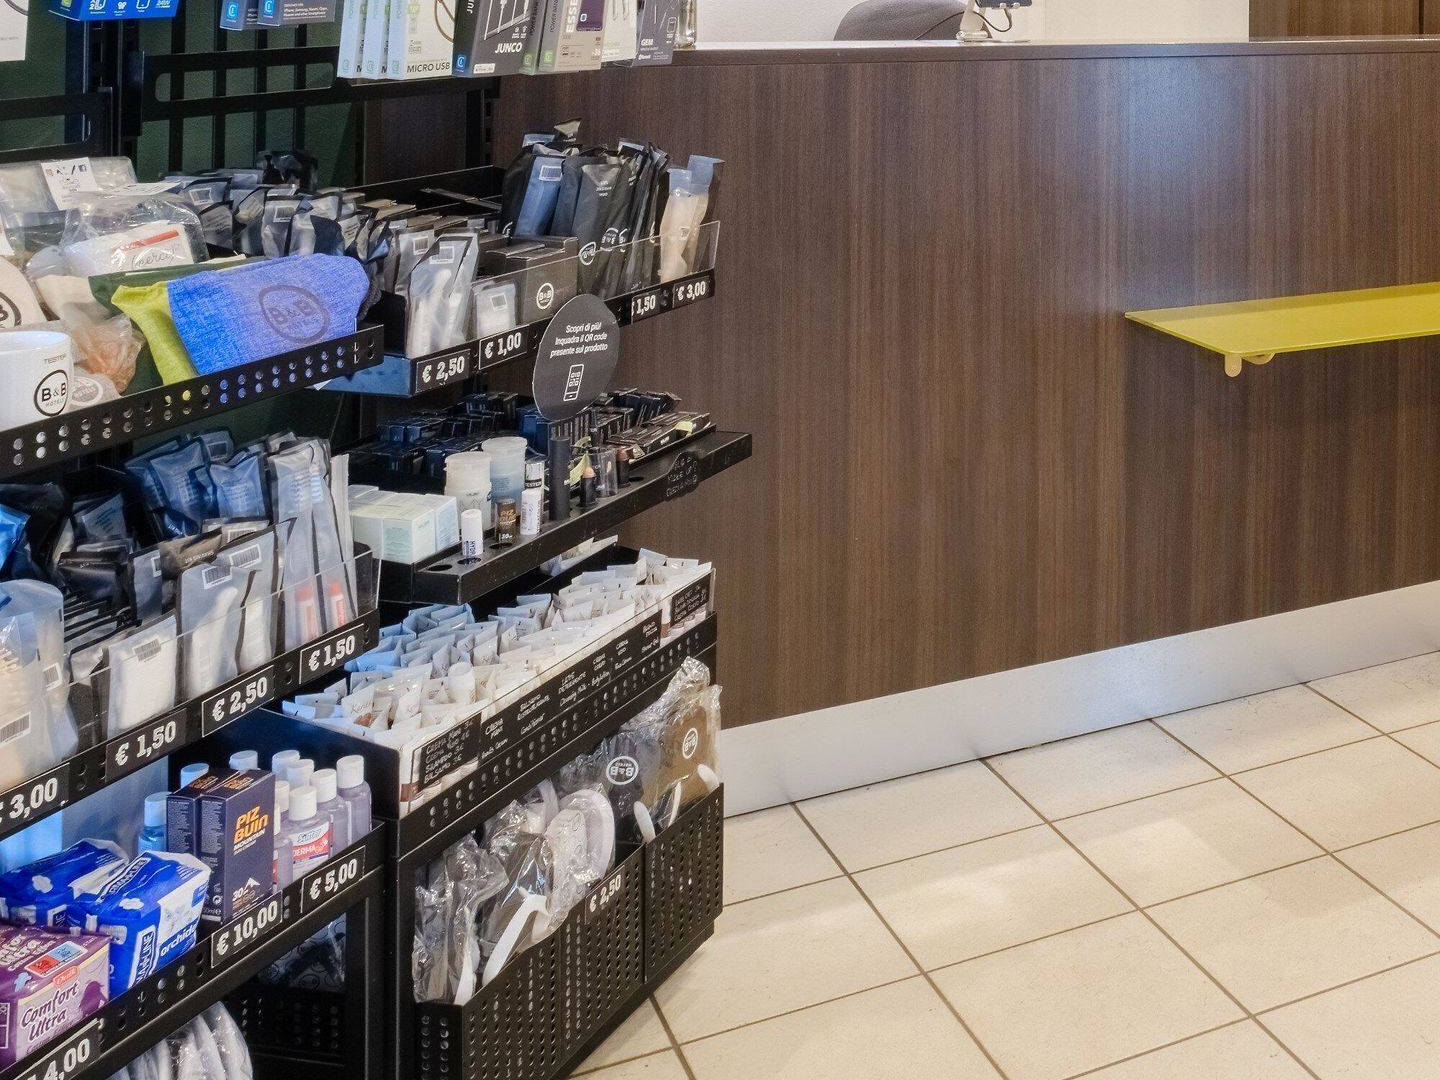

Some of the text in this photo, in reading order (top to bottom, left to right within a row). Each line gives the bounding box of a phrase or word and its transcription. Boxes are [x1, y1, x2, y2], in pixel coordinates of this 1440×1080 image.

[494, 41, 523, 54] JUNCO
[406, 61, 451, 74] MICRO USB
[686, 280, 707, 301] 3,00
[635, 294, 656, 316] 1,50
[554, 334, 580, 347] Inquadra
[593, 331, 608, 341] code
[565, 323, 584, 334] Scopri
[497, 332, 521, 357] 1,00
[549, 347, 575, 359] presente
[583, 342, 609, 355] prodotto
[436, 355, 465, 387] 2,50
[41, 381, 67, 402] B&B
[322, 635, 356, 667] 1,50
[230, 676, 268, 714] 2,50
[136, 721, 177, 758] 1,50
[10, 778, 58, 820] 3,00
[235, 805, 261, 831] PIZ
[233, 828, 266, 852] MOUNTAIN
[324, 857, 358, 893] 5,00
[232, 888, 245, 901] 30
[599, 874, 622, 906] 2,50
[233, 900, 279, 947] 10,00
[21, 980, 80, 1029] Comfort
[28, 1009, 67, 1042] Ultra
